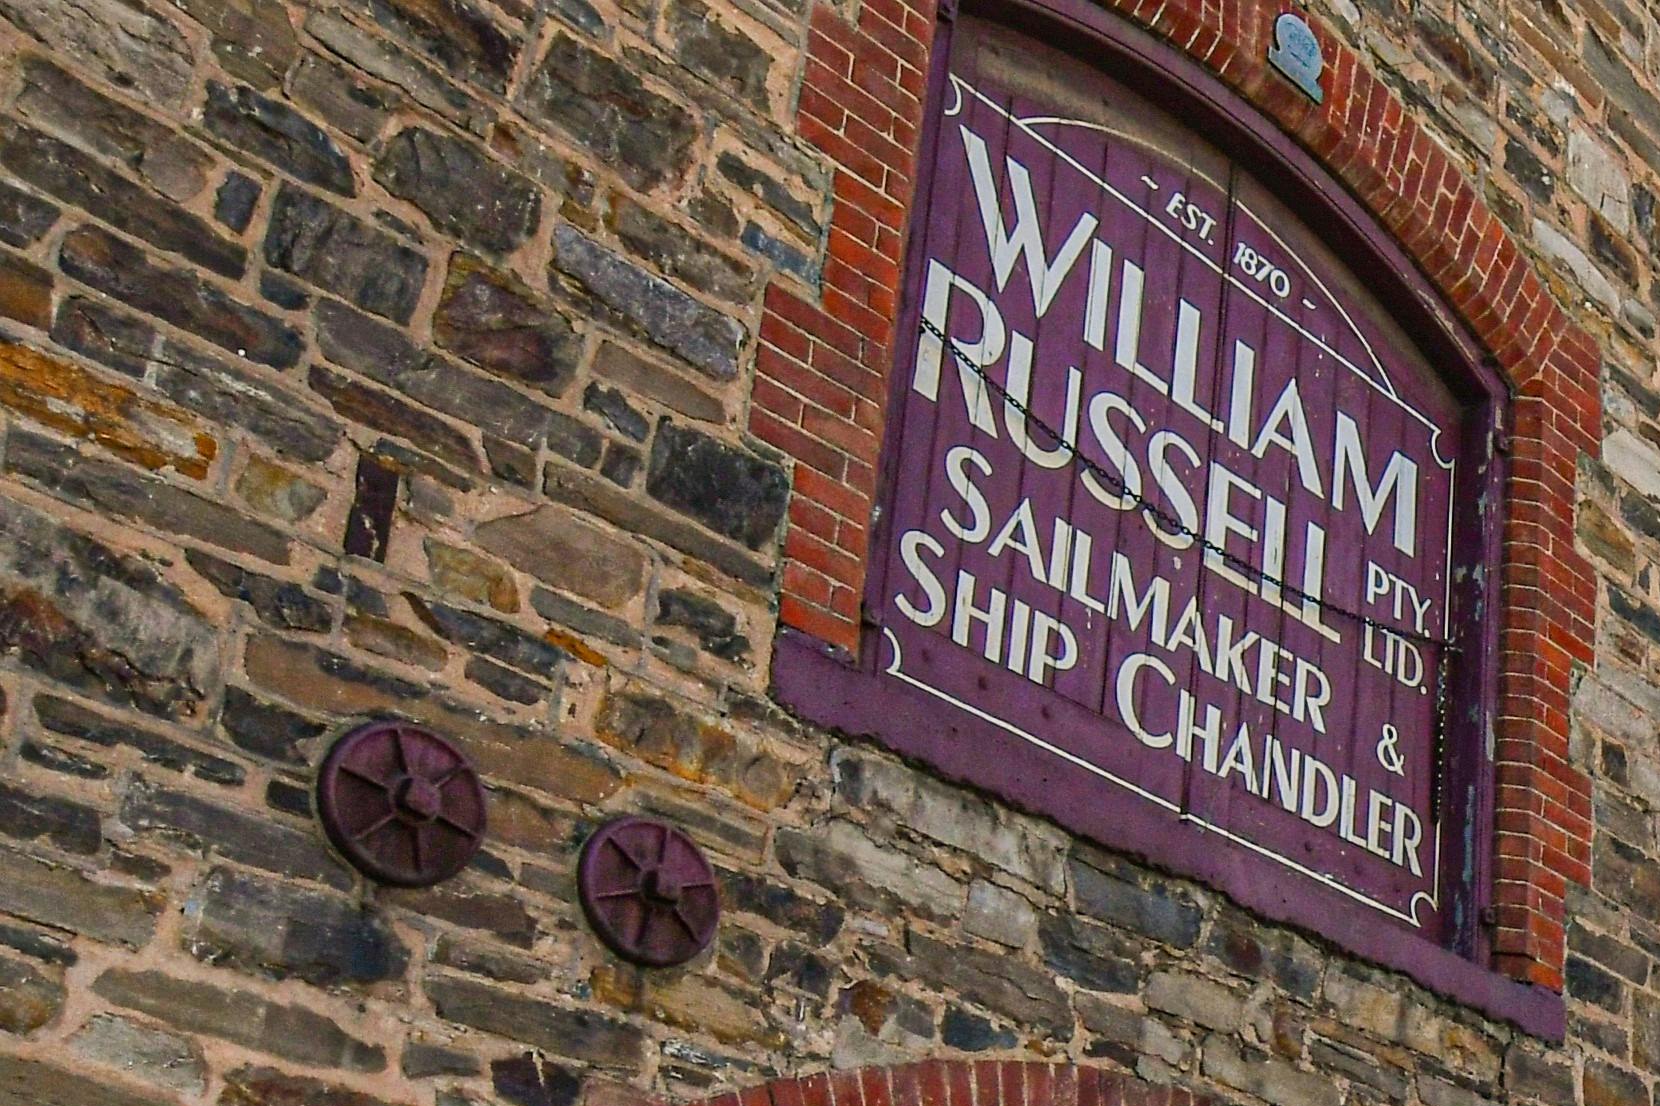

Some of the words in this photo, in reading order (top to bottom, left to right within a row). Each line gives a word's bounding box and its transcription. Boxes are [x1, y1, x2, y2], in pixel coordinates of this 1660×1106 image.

[960, 124, 1418, 558] WILLIAM
[1165, 193, 1216, 246] EST.
[1233, 240, 1292, 298] 1870
[912, 258, 1341, 645] RUSSELL
[940, 446, 1332, 734] SAILMAKER
[1363, 618, 1429, 695] LTD.
[1366, 560, 1432, 637] PTY.
[894, 529, 1079, 686] SHIP
[1116, 652, 1424, 878] CHANDLER
[1375, 722, 1406, 777] &
